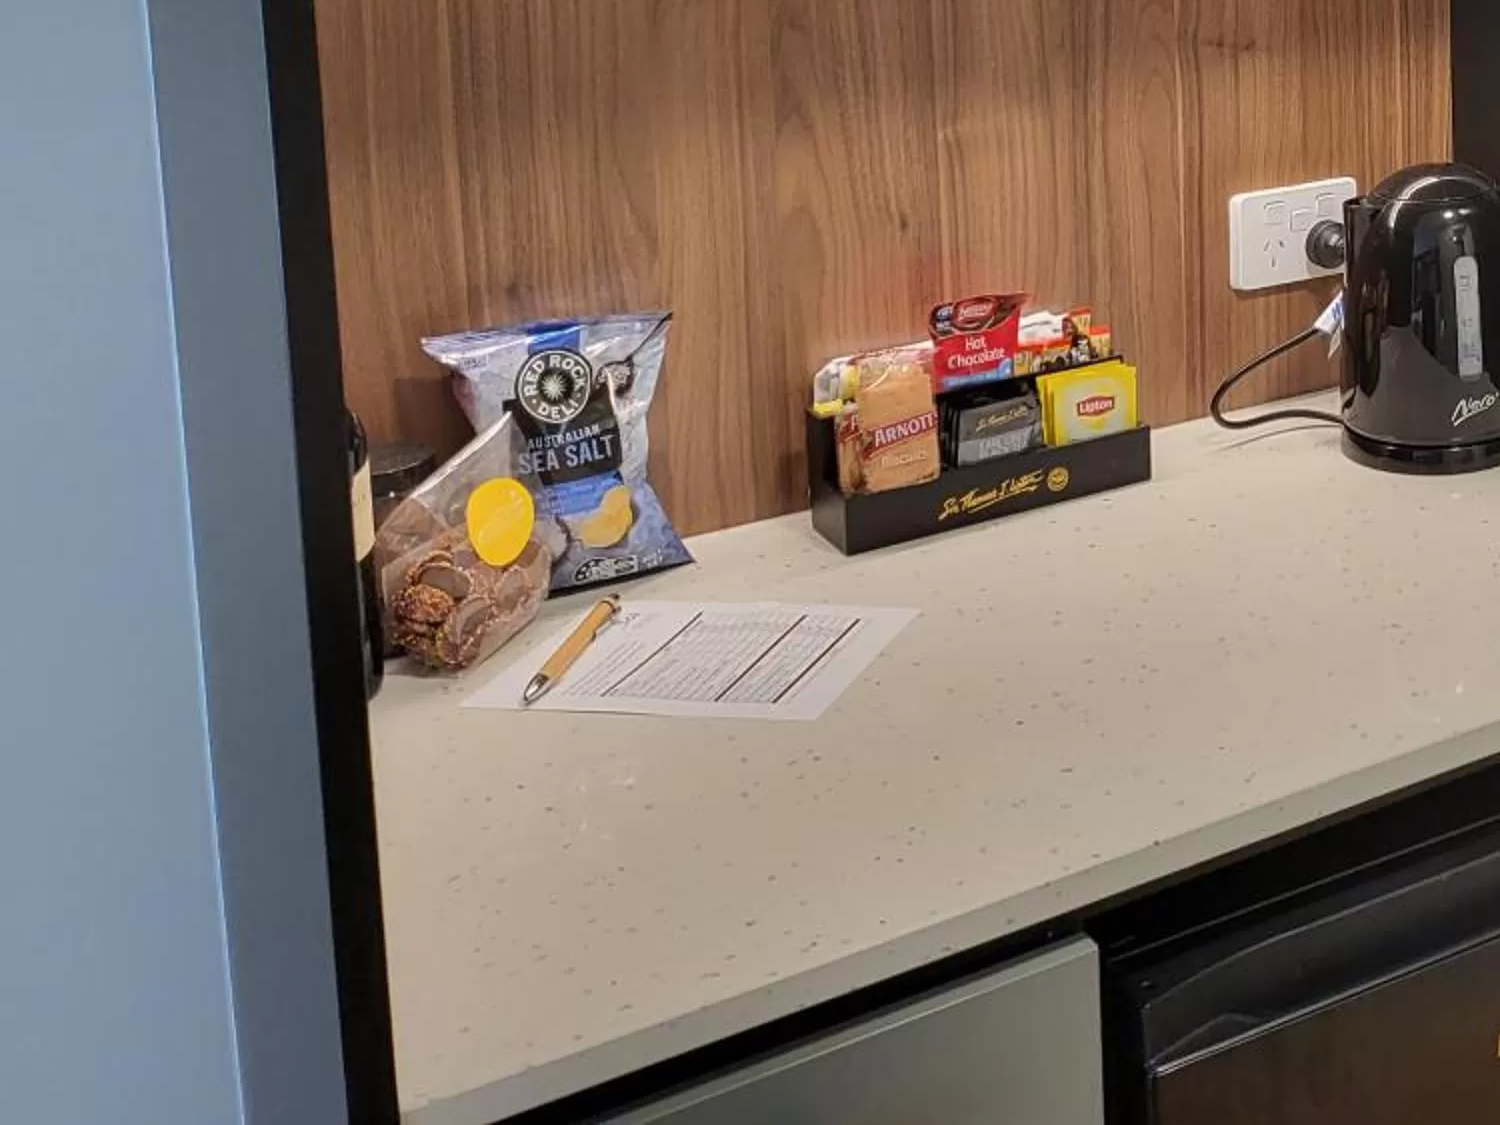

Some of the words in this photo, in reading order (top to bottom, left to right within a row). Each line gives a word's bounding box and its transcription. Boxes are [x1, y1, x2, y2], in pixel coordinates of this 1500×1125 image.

[965, 336, 987, 352] Hot
[947, 347, 1005, 370] Chocolate
[523, 359, 546, 397] RED
[549, 355, 586, 392] ROCK
[537, 399, 579, 419] DELI
[1079, 397, 1113, 414] Lipton
[528, 423, 601, 450] AUSTRALIAN
[517, 448, 560, 475] SEA
[564, 434, 615, 468] SALT
